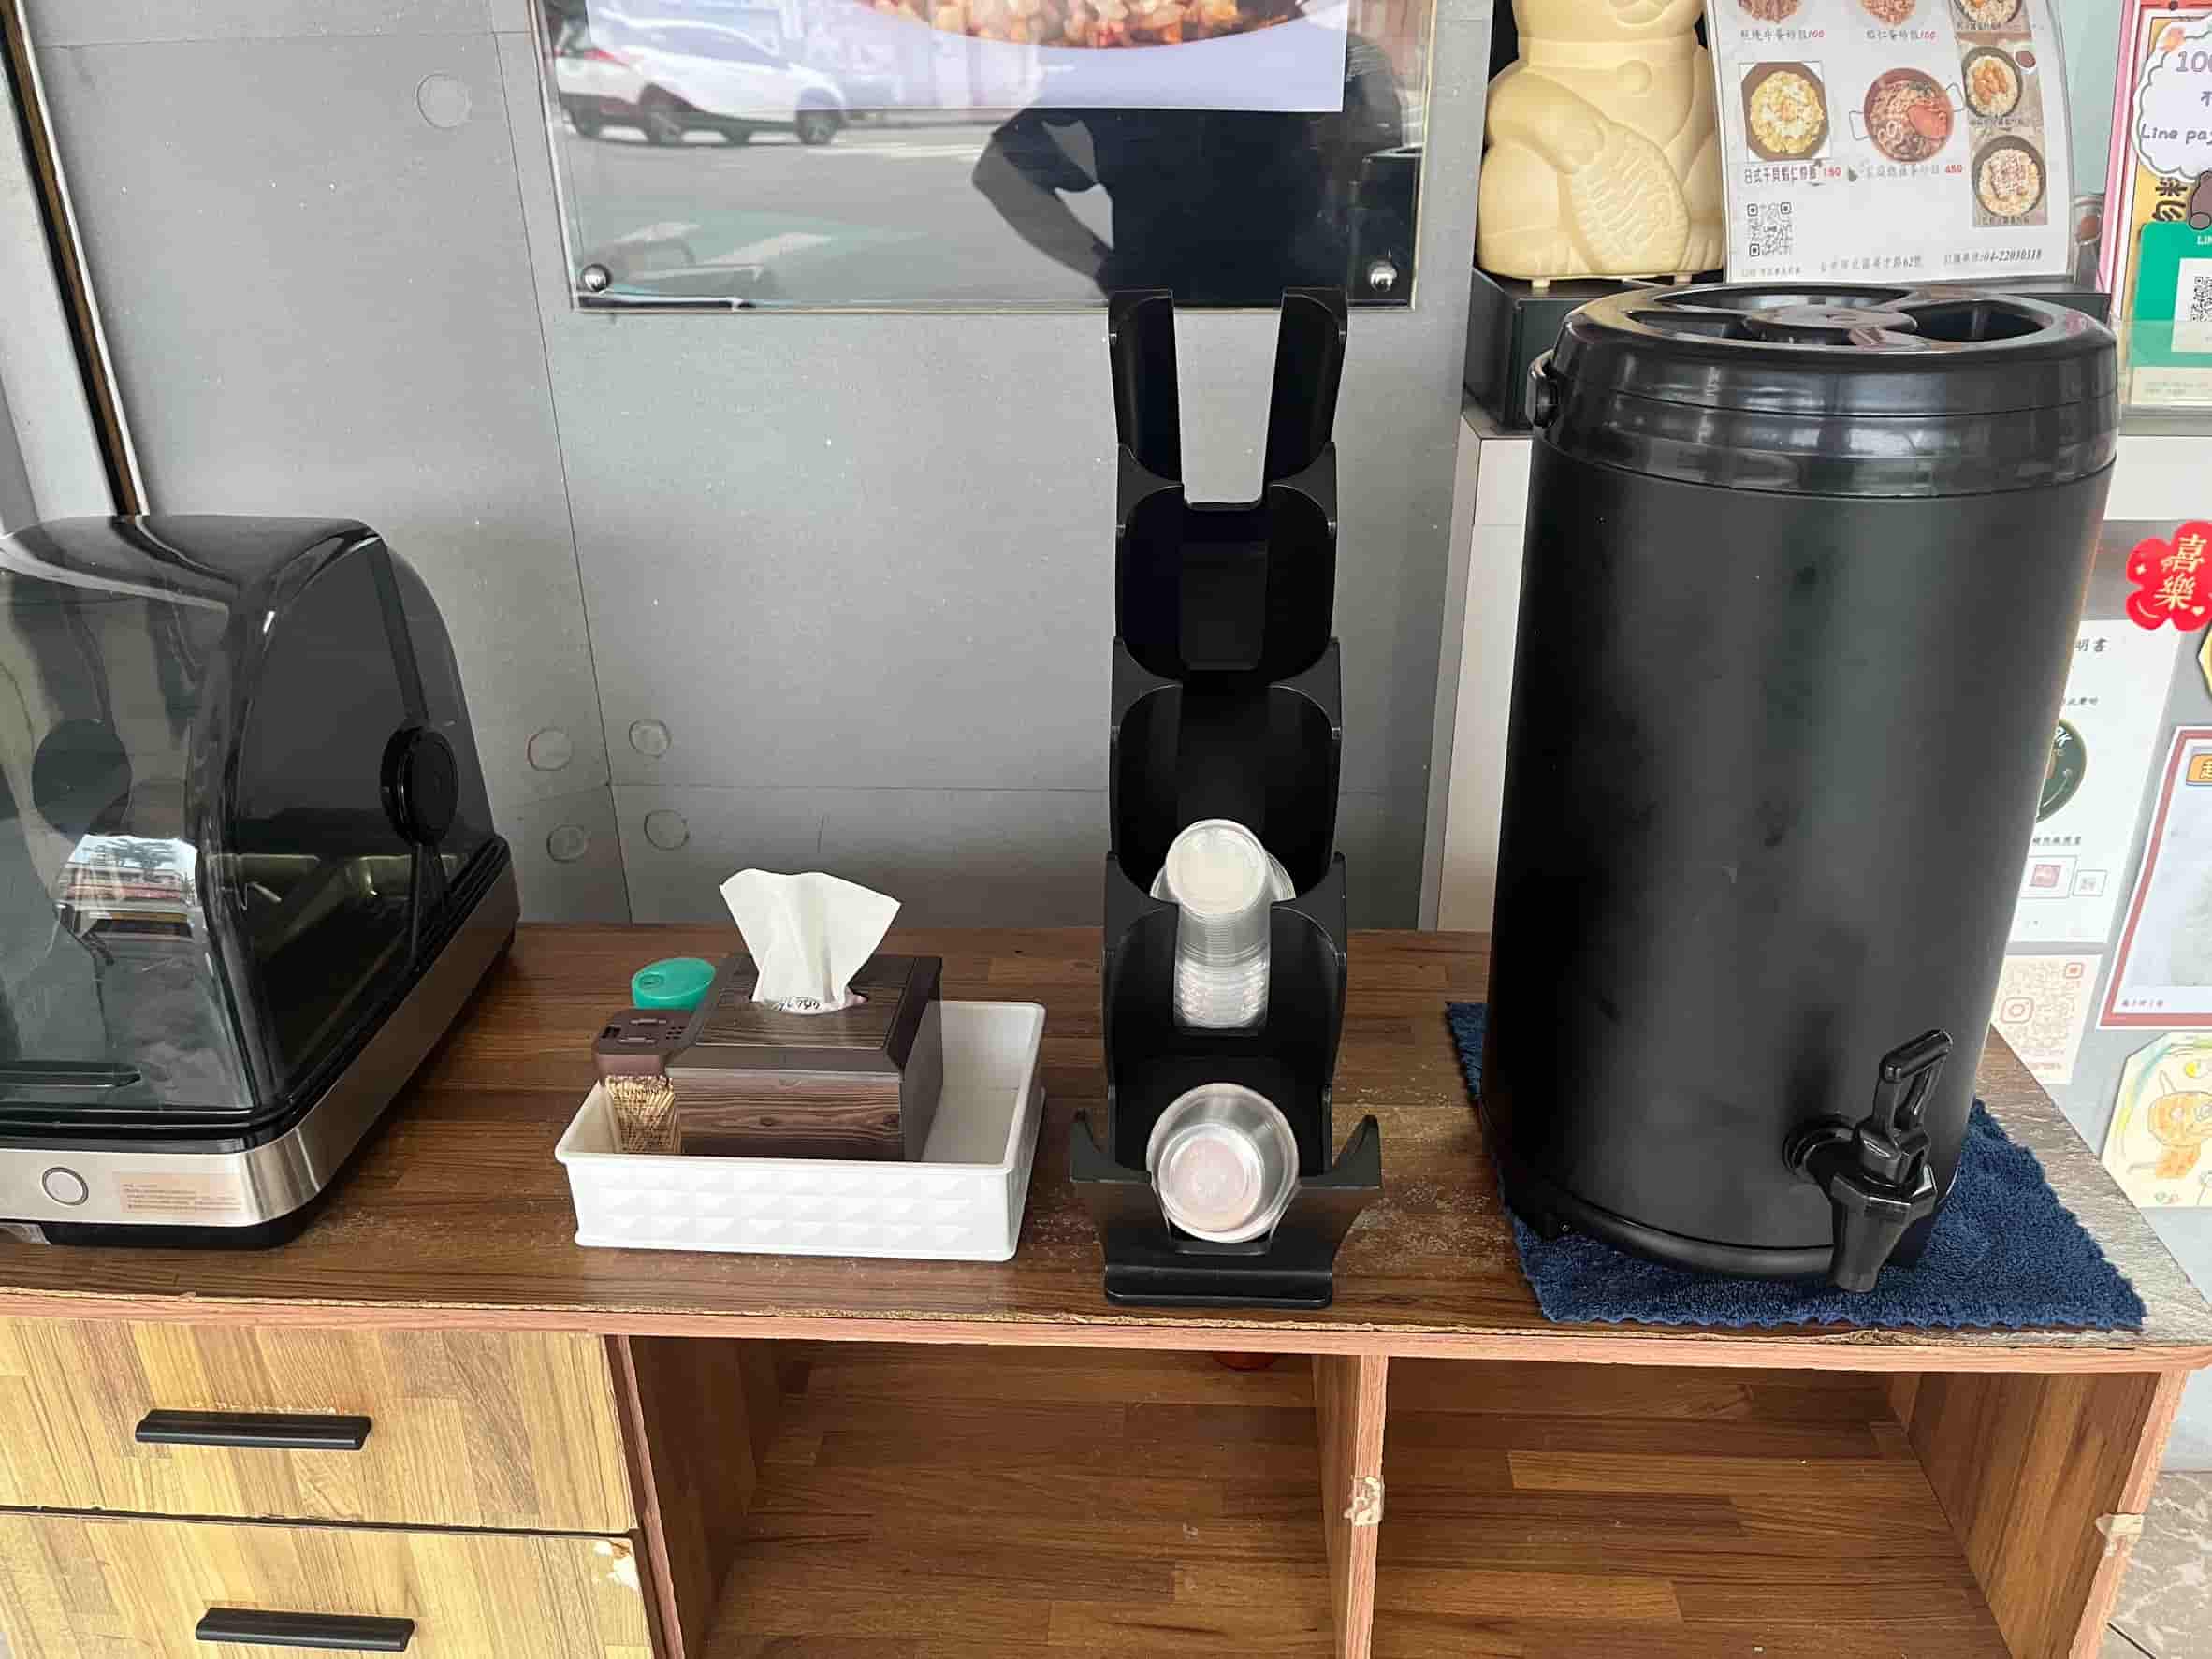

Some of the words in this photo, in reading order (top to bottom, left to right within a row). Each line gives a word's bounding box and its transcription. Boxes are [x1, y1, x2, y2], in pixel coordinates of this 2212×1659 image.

[2176, 51, 2212, 73] 10
[2141, 123, 2178, 140] Line
[2154, 532, 2206, 611] 喜樂
